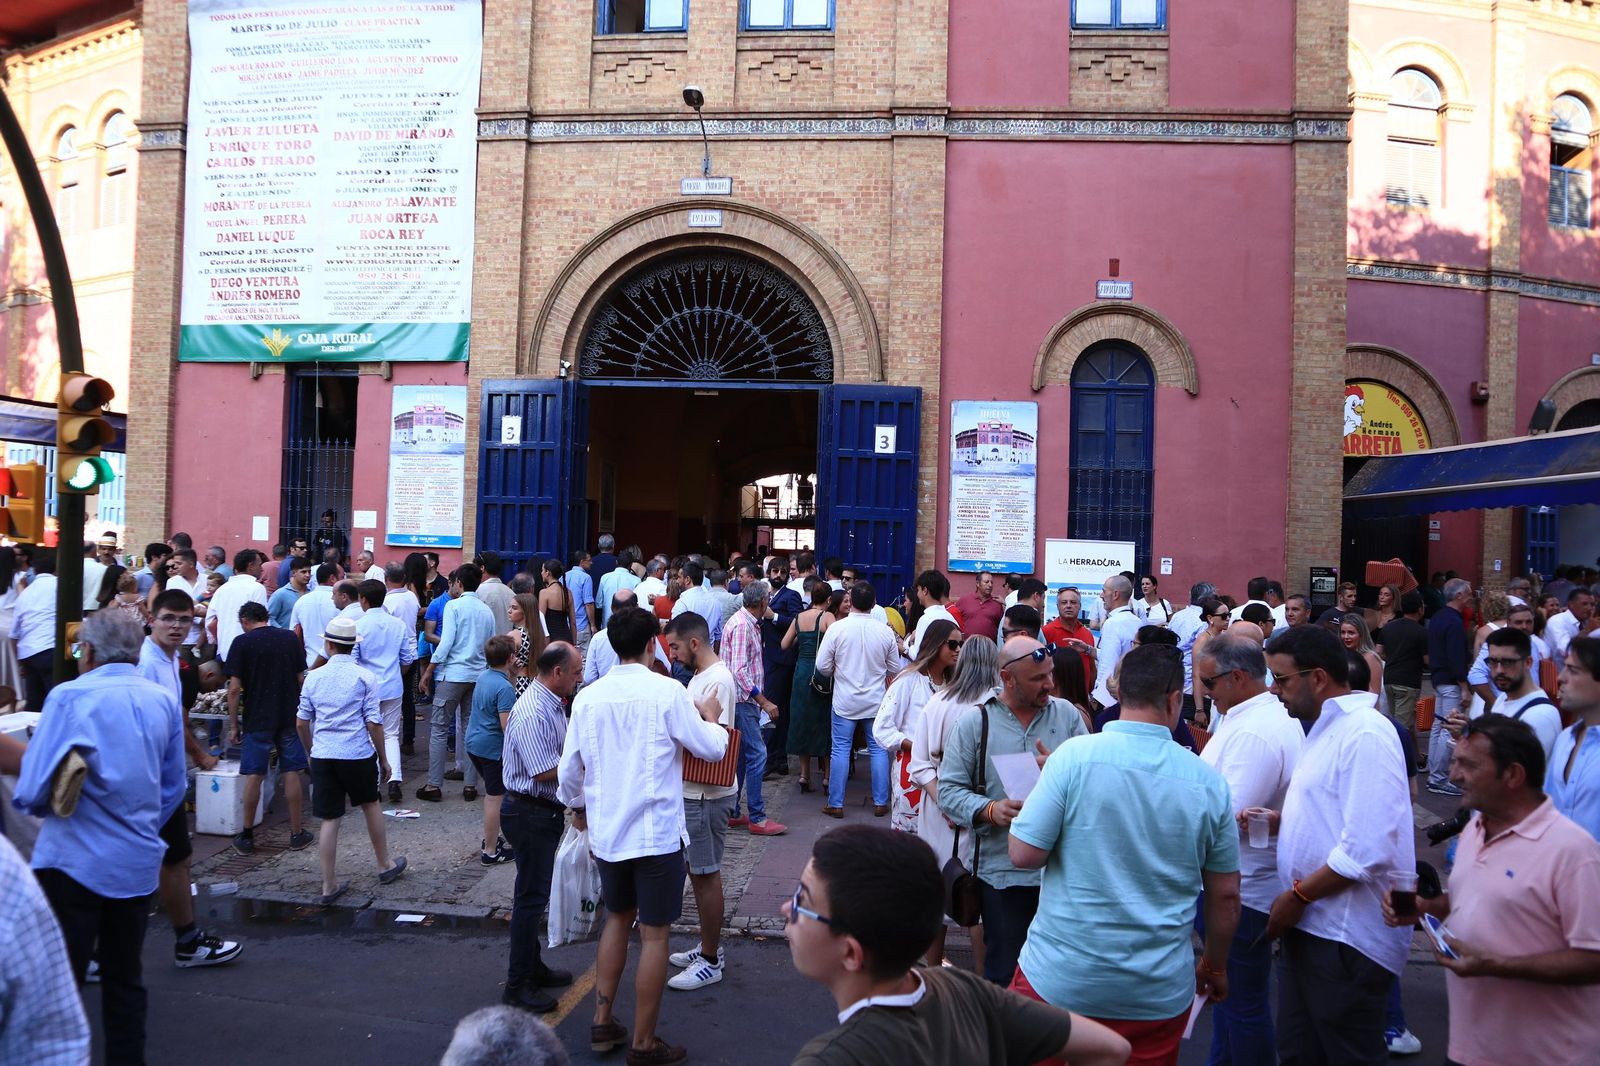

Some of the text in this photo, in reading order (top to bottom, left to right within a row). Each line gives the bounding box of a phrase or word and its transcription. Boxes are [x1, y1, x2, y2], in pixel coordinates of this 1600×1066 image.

[209, 14, 236, 22] TODOS
[255, 10, 295, 18] FESTEJOS
[231, 23, 272, 33] MARTES
[289, 21, 301, 29] DE
[306, 19, 338, 29] JULIO
[255, 61, 286, 69] ROSADO
[290, 57, 336, 67] GUILLERMO
[337, 56, 359, 64] LUNA
[420, 55, 459, 64] ANTONIO
[298, 70, 320, 78] JAIME
[324, 69, 358, 77] PADILLA
[204, 123, 319, 137] JAVIER ZULUETA
[333, 128, 456, 141] DAVID DE MIRANDA
[209, 139, 312, 152] ENRIQUE TORO
[206, 155, 316, 168] CARLOS TIRADO
[204, 172, 246, 180] VIERNES
[227, 189, 291, 197] ZALDUENDO
[405, 186, 446, 194] DOMECQ
[204, 200, 255, 212] MORANTE
[331, 196, 457, 208] ALEJANDRO TALAVANTE
[206, 220, 233, 228] MIGUEL
[263, 214, 308, 225] PERERA
[347, 212, 439, 224] JUAN ORTEGA
[216, 230, 295, 243] DANIEL LUQUE
[359, 229, 425, 240] ROCA REY
[259, 257, 297, 265] Rejones
[210, 276, 299, 288] DIEGO VENTURA
[209, 287, 300, 301] ANDRÉS ROMERO
[298, 333, 375, 344] CAJA RURAL
[1369, 419, 1393, 429] Andrés
[1400, 403, 1413, 418] 959
[1409, 417, 1419, 428] 26
[1414, 427, 1423, 438] 22
[506, 426, 515, 441] 3
[1362, 427, 1400, 437] Hermano
[879, 435, 890, 450] 3
[1069, 558, 1121, 567] HERRADURA
